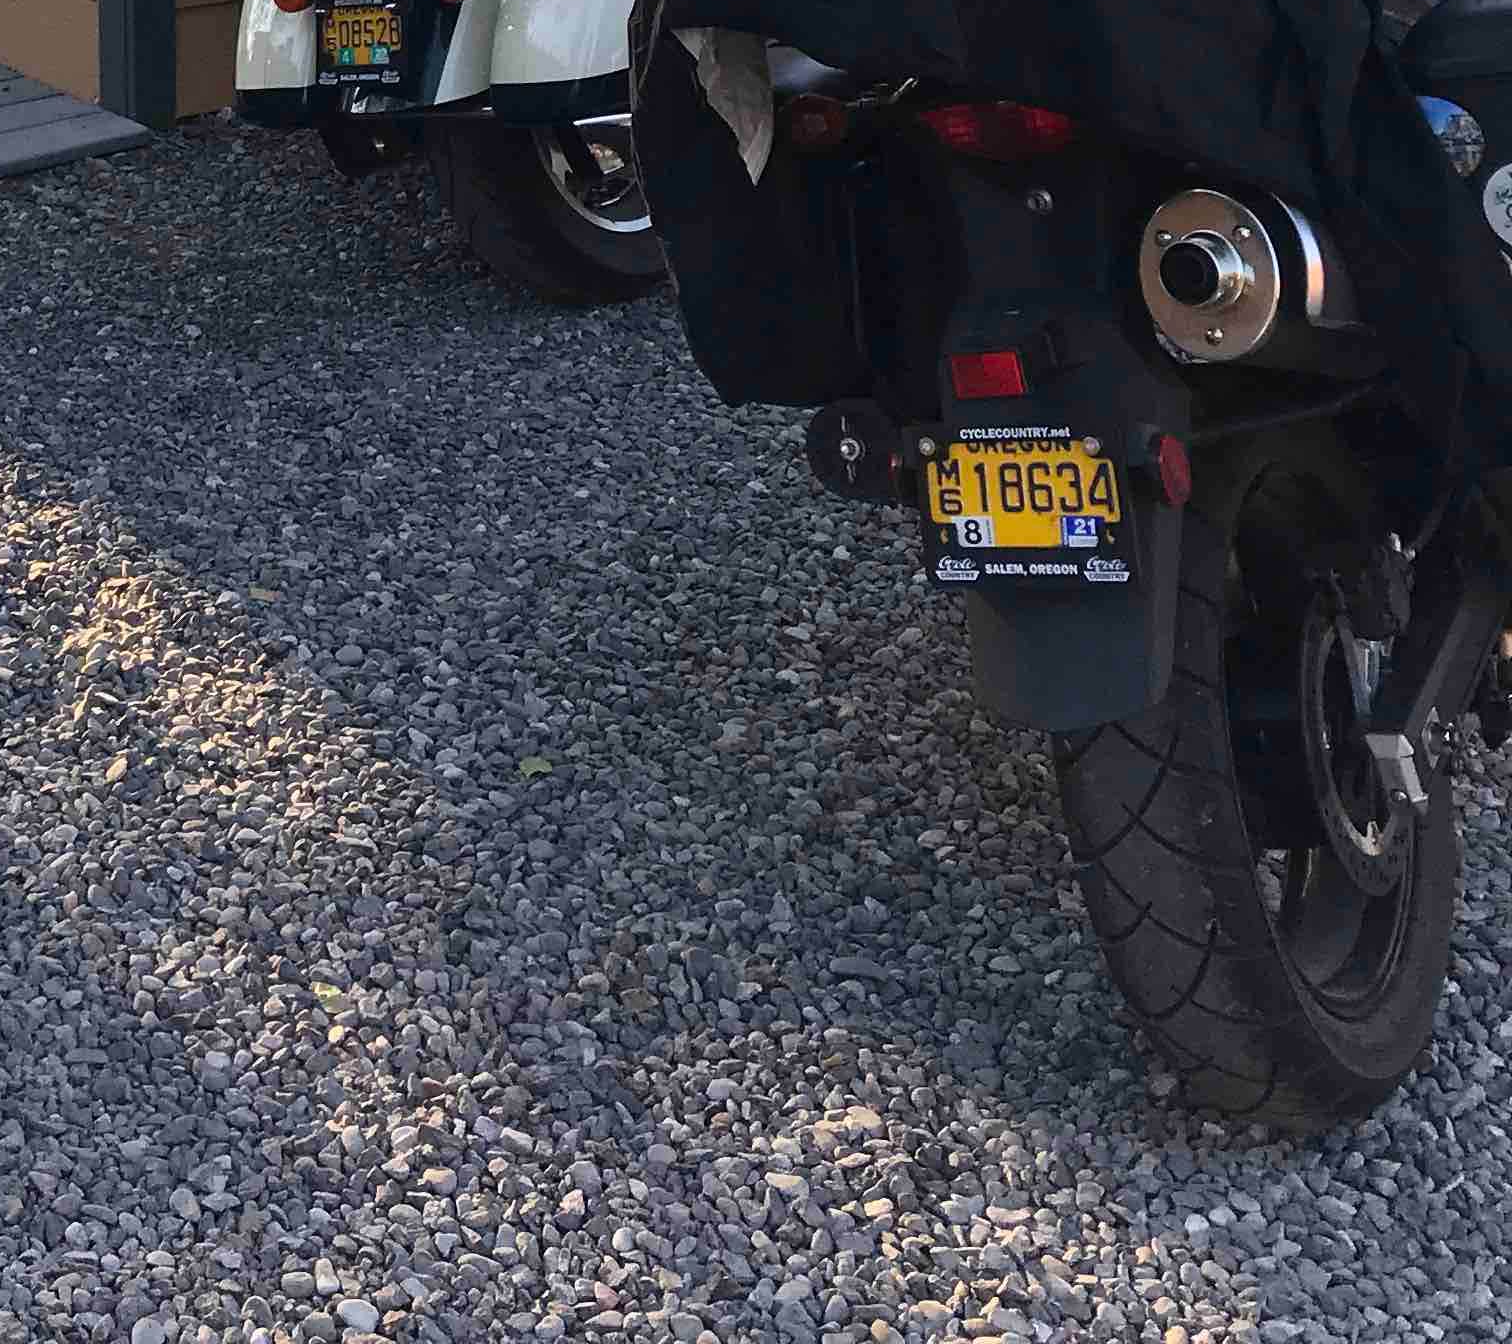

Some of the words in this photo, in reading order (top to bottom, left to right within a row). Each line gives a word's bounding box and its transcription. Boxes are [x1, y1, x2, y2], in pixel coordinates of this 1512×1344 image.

[338, 16, 401, 49] 08528
[959, 427, 1071, 440] CYCLECOUNTRY.net
[973, 461, 1117, 517] 18634
[963, 518, 984, 545] 8
[1073, 517, 1098, 536] 21
[984, 562, 1028, 576] SALEM,
[1029, 563, 1079, 576] OREGON
